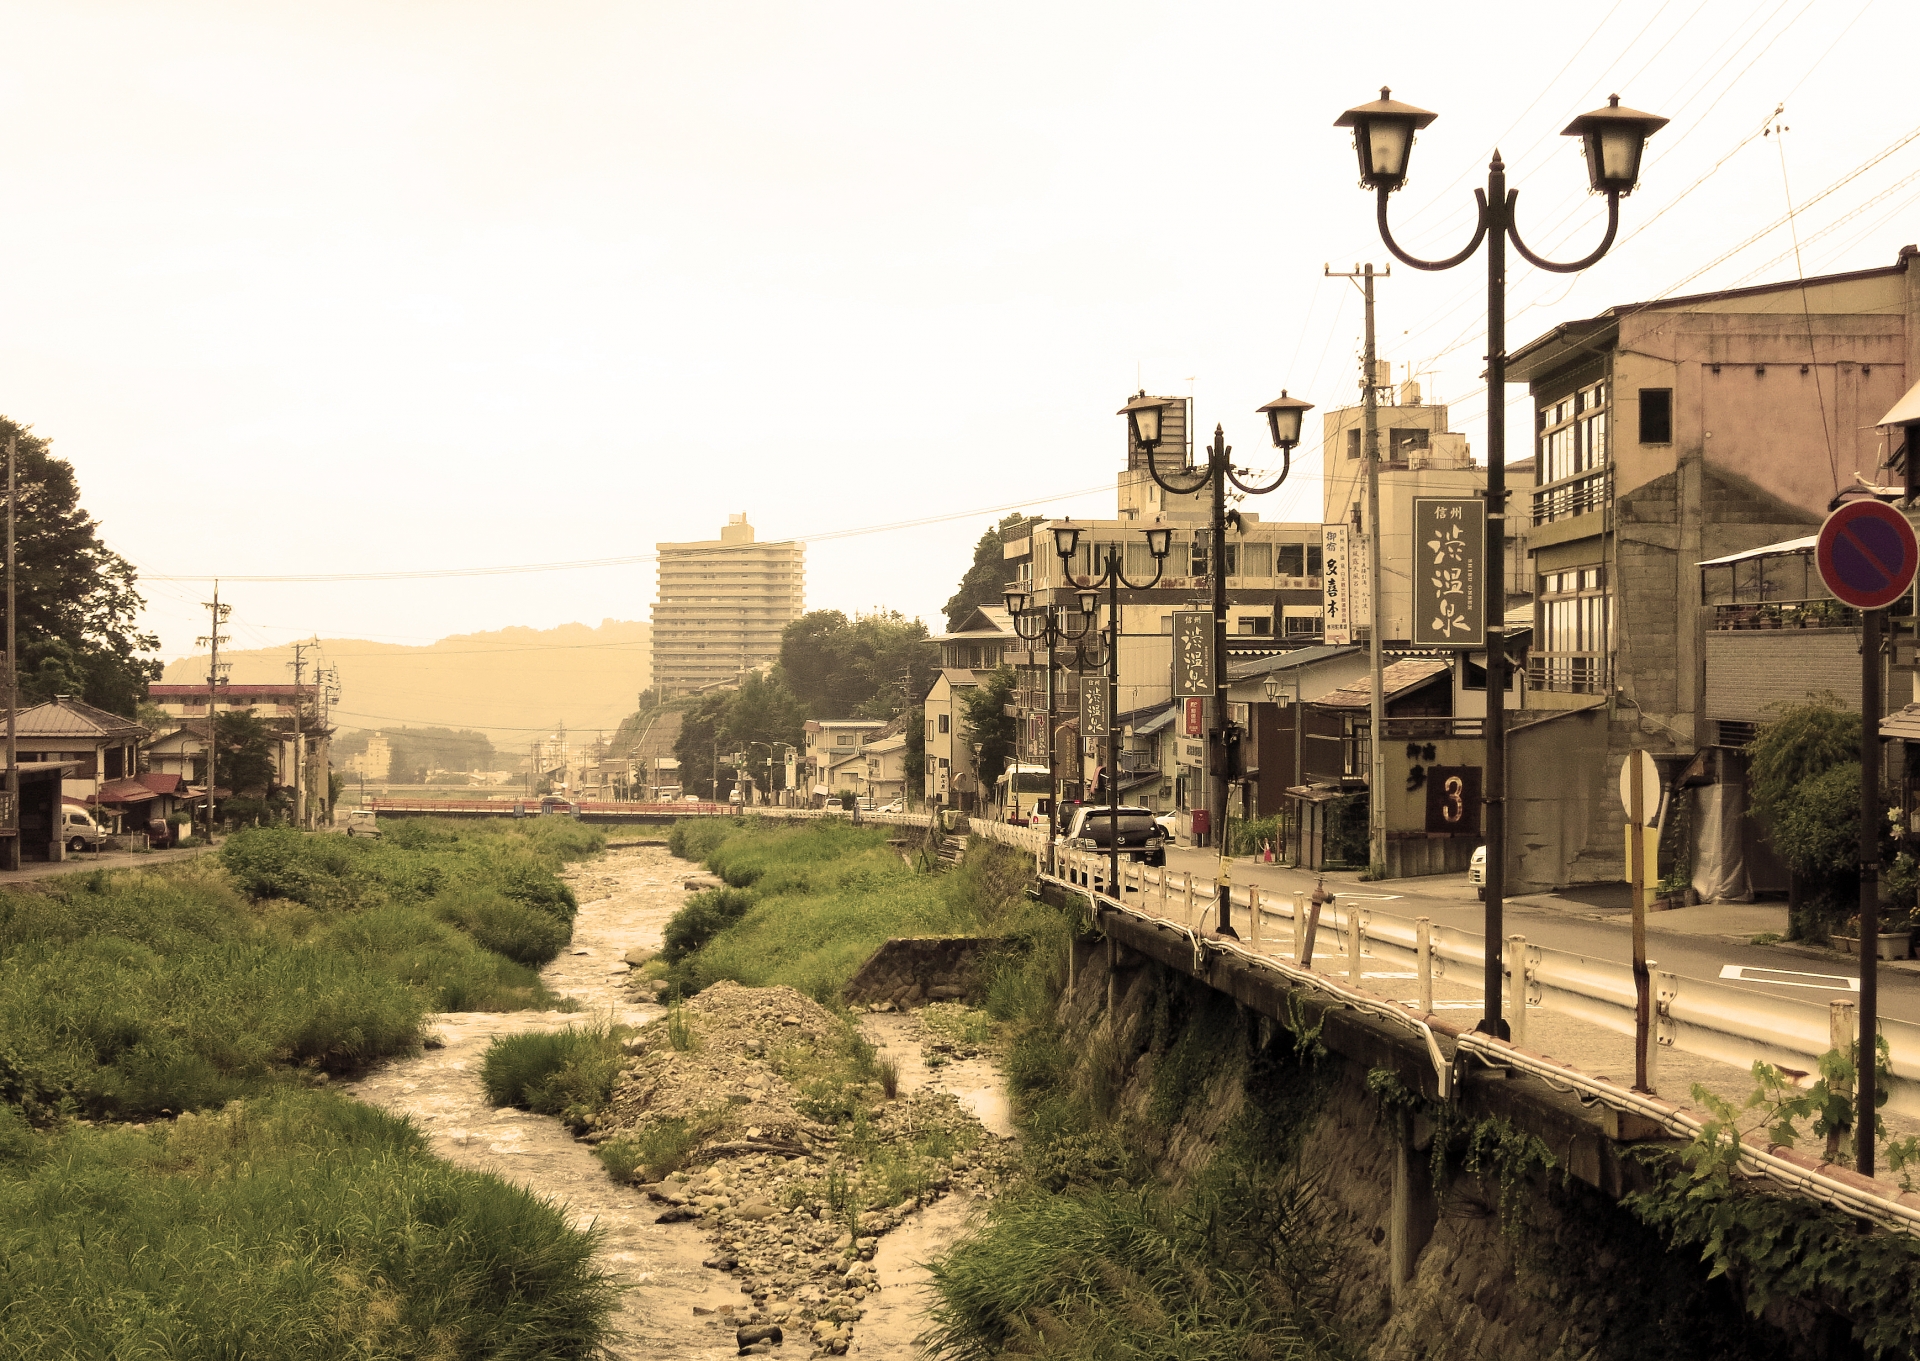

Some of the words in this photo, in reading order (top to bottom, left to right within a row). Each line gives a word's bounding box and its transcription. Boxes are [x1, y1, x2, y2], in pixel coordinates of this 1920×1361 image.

[1434, 506, 1462, 520] 信州
[1427, 524, 1471, 638] 渋温泉
[1185, 615, 1202, 624] 信州
[1180, 626, 1208, 692] 渋温泉
[1085, 687, 1104, 734] 渋温泉
[1442, 776, 1463, 822] 3
